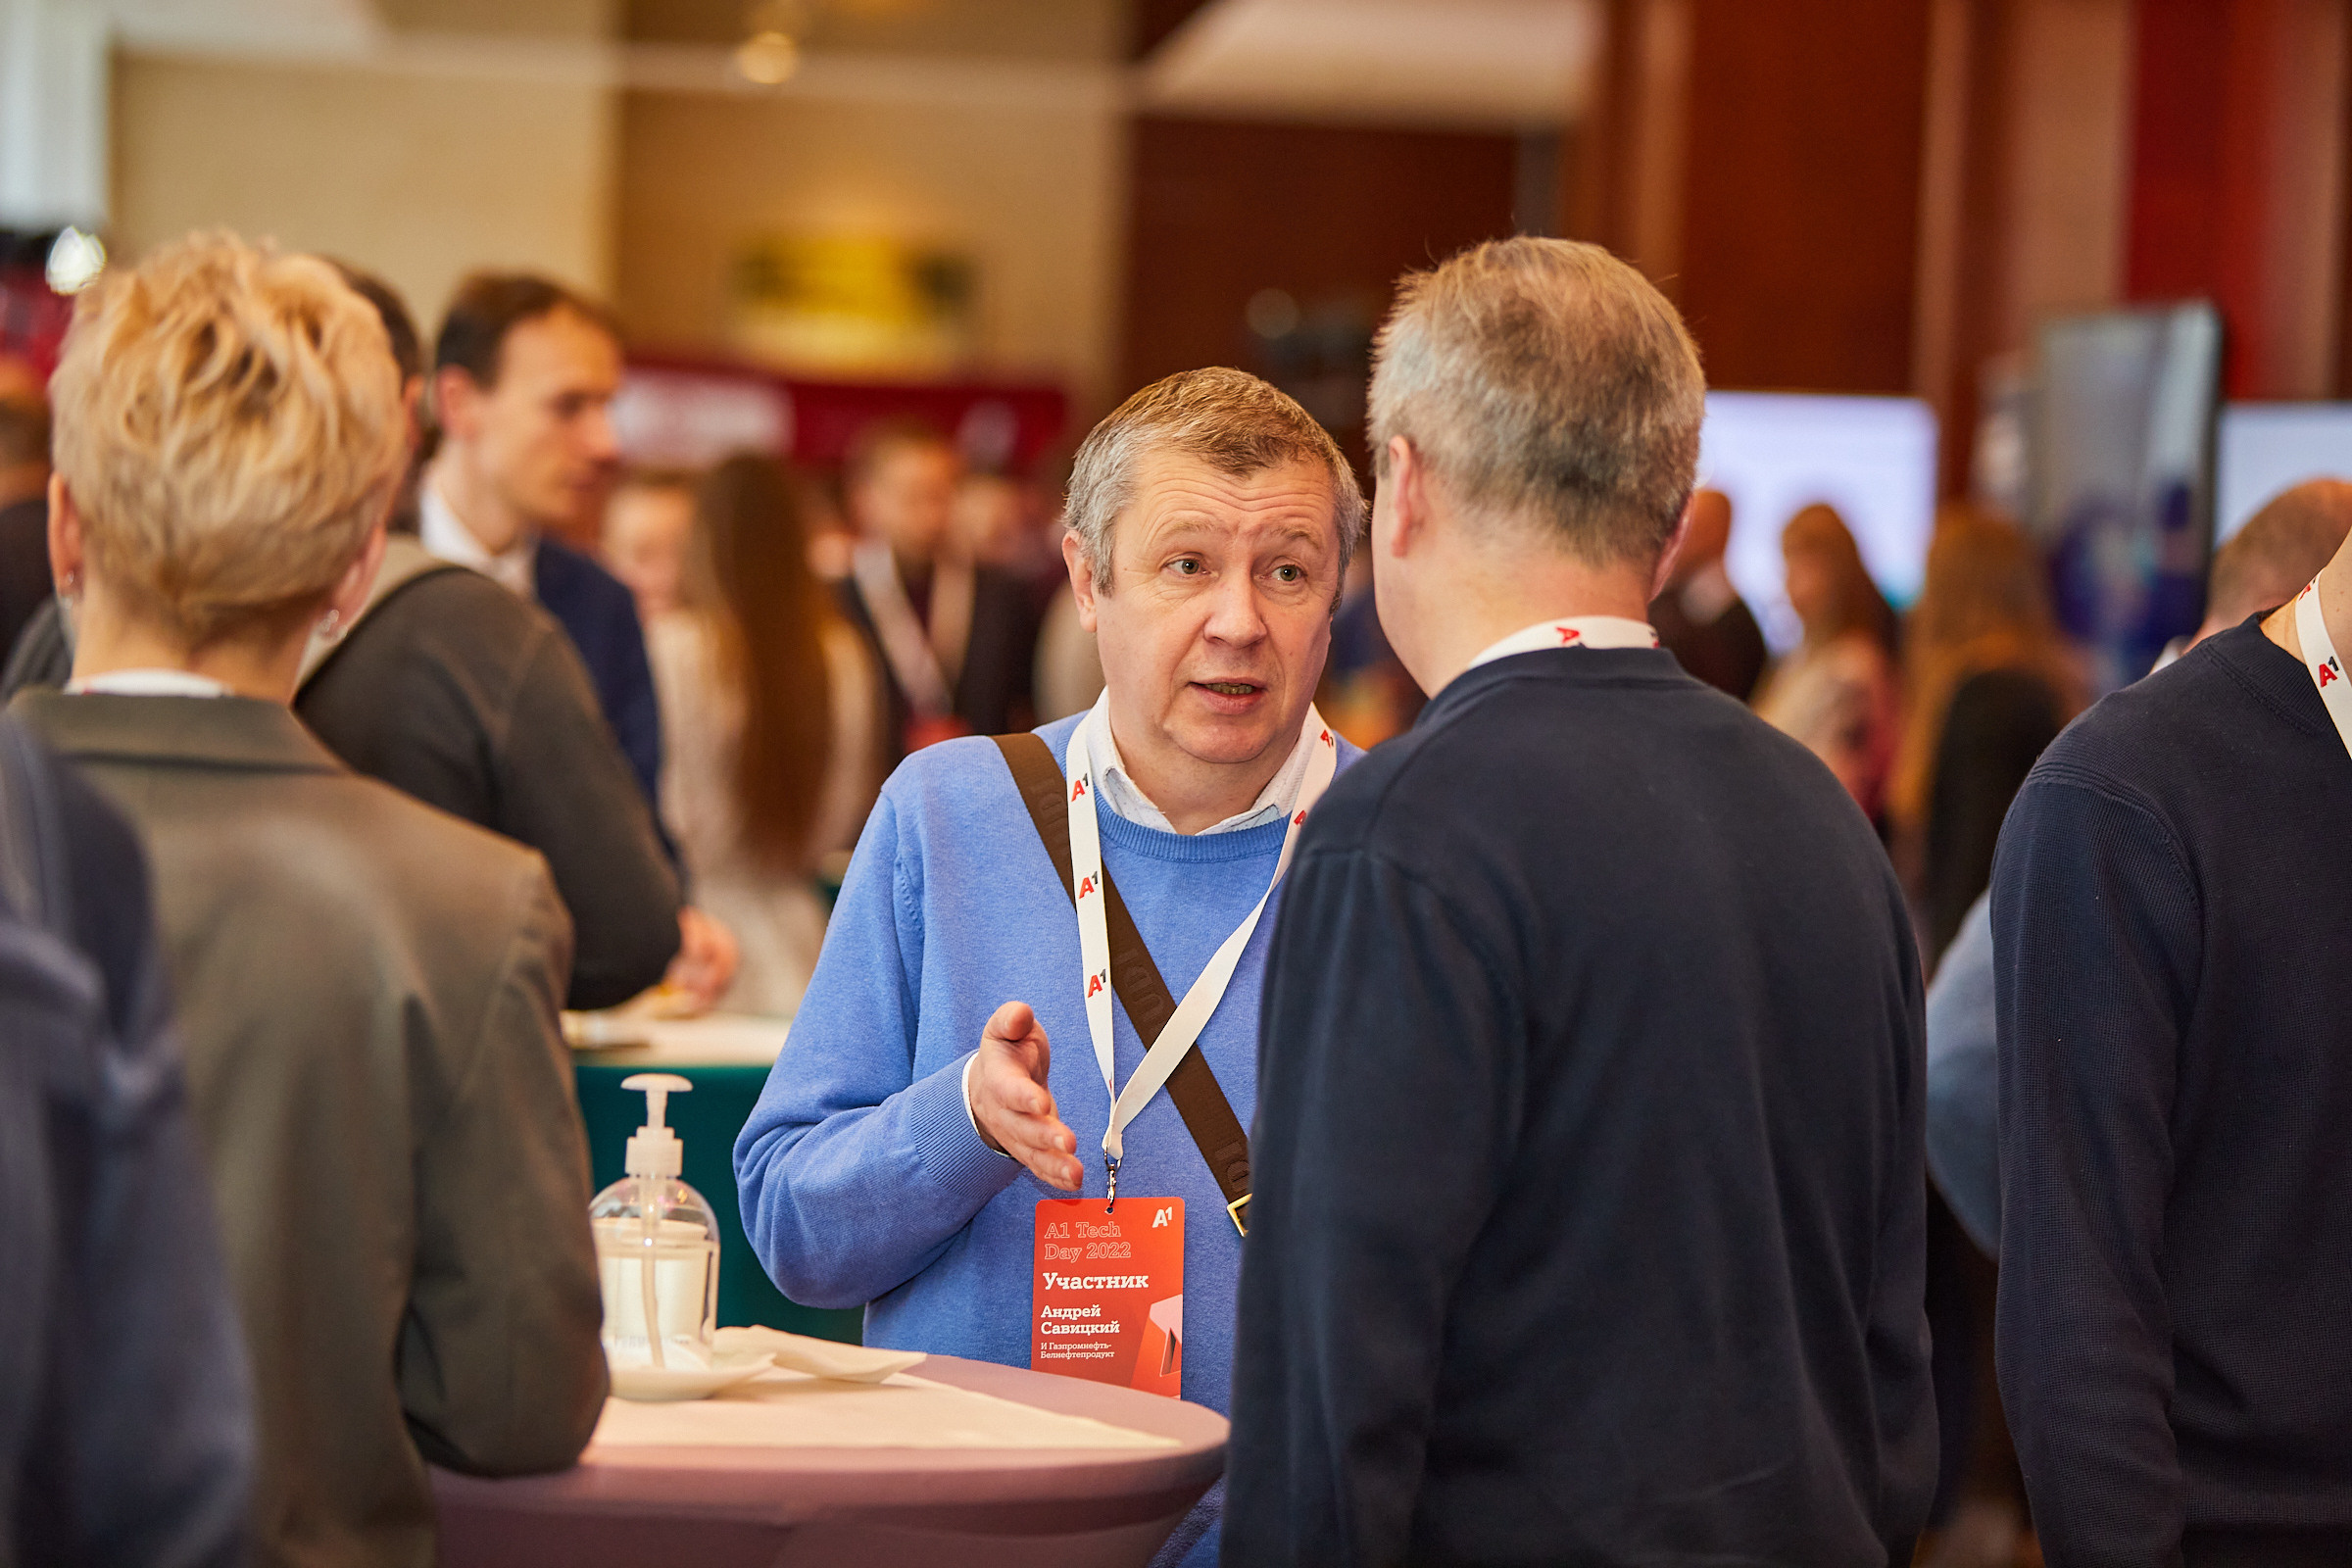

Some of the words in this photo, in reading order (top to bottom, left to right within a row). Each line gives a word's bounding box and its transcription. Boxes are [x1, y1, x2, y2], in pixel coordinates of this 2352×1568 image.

[2319, 656, 2339, 688] A1
[1071, 772, 1089, 803] A1
[1079, 870, 1099, 900] A1
[1088, 968, 1106, 999] A1
[1152, 1206, 1173, 1228] A1
[1044, 1222, 1070, 1239] A1
[1076, 1221, 1121, 1238] Tech
[1044, 1244, 1082, 1263] Day
[1086, 1242, 1131, 1258] 2022
[1043, 1272, 1149, 1290] Участник
[1041, 1304, 1102, 1320] Андрей
[1041, 1320, 1120, 1336] Савицкий
[1040, 1350, 1115, 1360] Белнефтепродукт
[1049, 1342, 1112, 1351] Газпромнефть-
